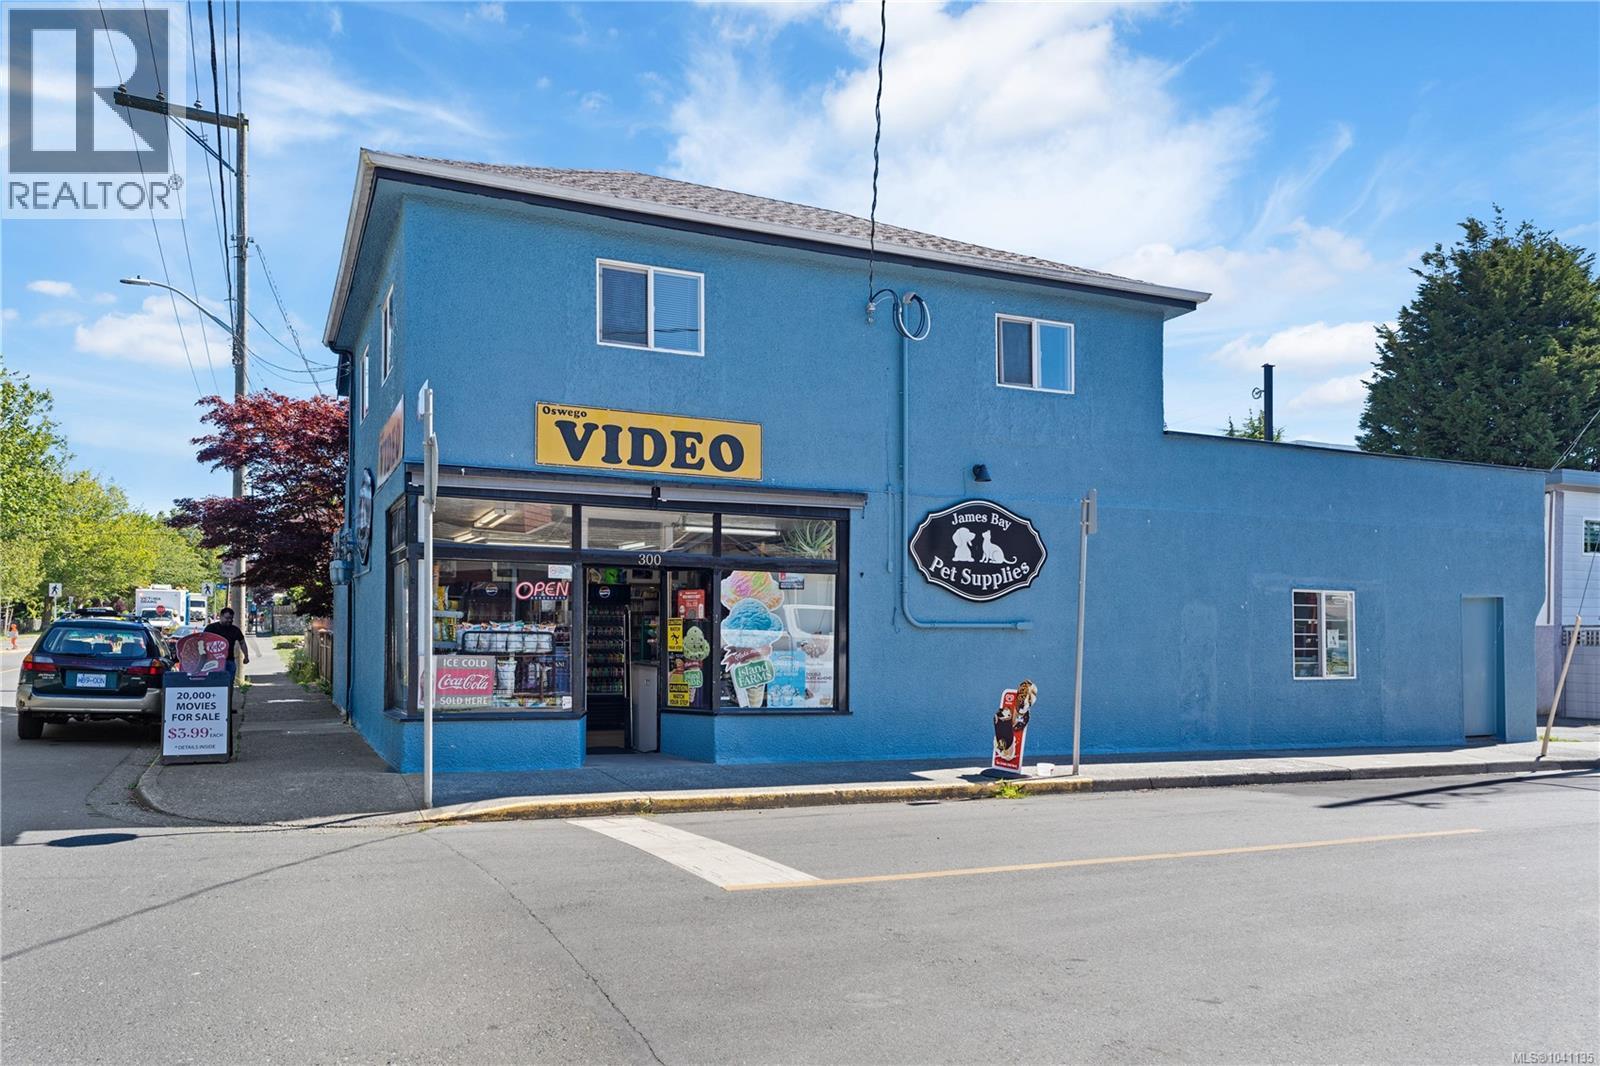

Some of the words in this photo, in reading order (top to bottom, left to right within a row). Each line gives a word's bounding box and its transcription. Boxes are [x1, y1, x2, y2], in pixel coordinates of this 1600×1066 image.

[542, 405, 587, 419] Oswego
[554, 419, 745, 473] VIDEO
[951, 512, 988, 526] James
[990, 512, 1012, 531] Bay
[638, 553, 662, 566] 300
[929, 556, 957, 582] Pet
[960, 561, 1030, 591] Supplies
[515, 581, 569, 600] OPEN
[443, 658, 459, 667] ICE
[462, 658, 488, 668] COLD
[739, 671, 772, 687] FARMS
[176, 691, 216, 701] 20,000+
[440, 696, 463, 705] SOLD
[465, 696, 488, 705] HERE
[176, 702, 216, 711] MOVIES
[172, 713, 193, 722] FOR
[194, 712, 220, 721] SALE
